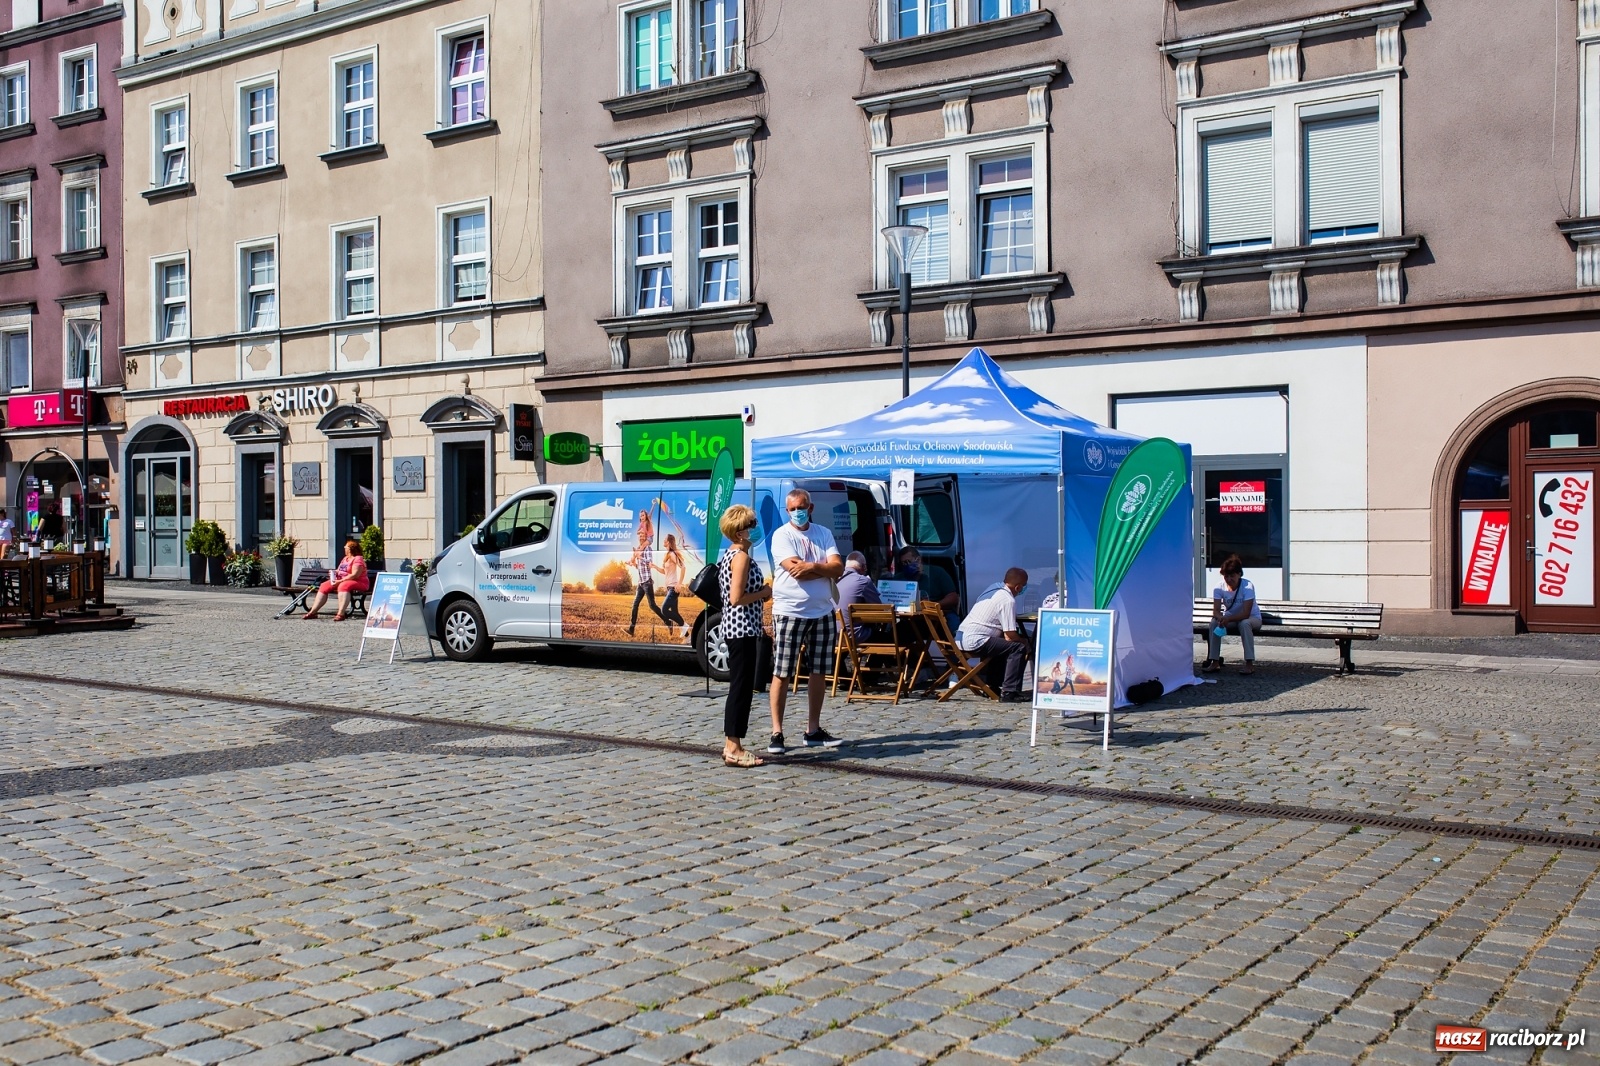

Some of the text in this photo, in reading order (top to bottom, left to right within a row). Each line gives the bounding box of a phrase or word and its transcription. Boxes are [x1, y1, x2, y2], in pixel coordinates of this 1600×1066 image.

[273, 384, 334, 412] SHIRO
[163, 395, 248, 415] RESTAURACJA
[554, 440, 588, 453] żabka
[638, 430, 726, 461] żabka
[840, 440, 1014, 454] Wojewódzki Fundusz Ochrony Środowiska
[840, 458, 844, 467] i
[846, 455, 892, 468] Gospodarki
[894, 454, 925, 467] Wodnej
[936, 456, 985, 465] Katowicach
[1221, 496, 1264, 504] WYNAJMĘ
[578, 521, 632, 530] czyste powietrze
[578, 530, 631, 540] zdrowy wybór
[1538, 558, 1570, 598] 602
[1558, 476, 1590, 516] 432
[1468, 520, 1507, 592] WYNAJMĘ
[489, 562, 512, 570] Wymień
[490, 572, 528, 580] przeprowadź
[478, 584, 536, 592] termomodernizację
[486, 594, 511, 602] swojego
[1052, 616, 1100, 627] MOBILNE
[1058, 628, 1092, 638] BIURO
